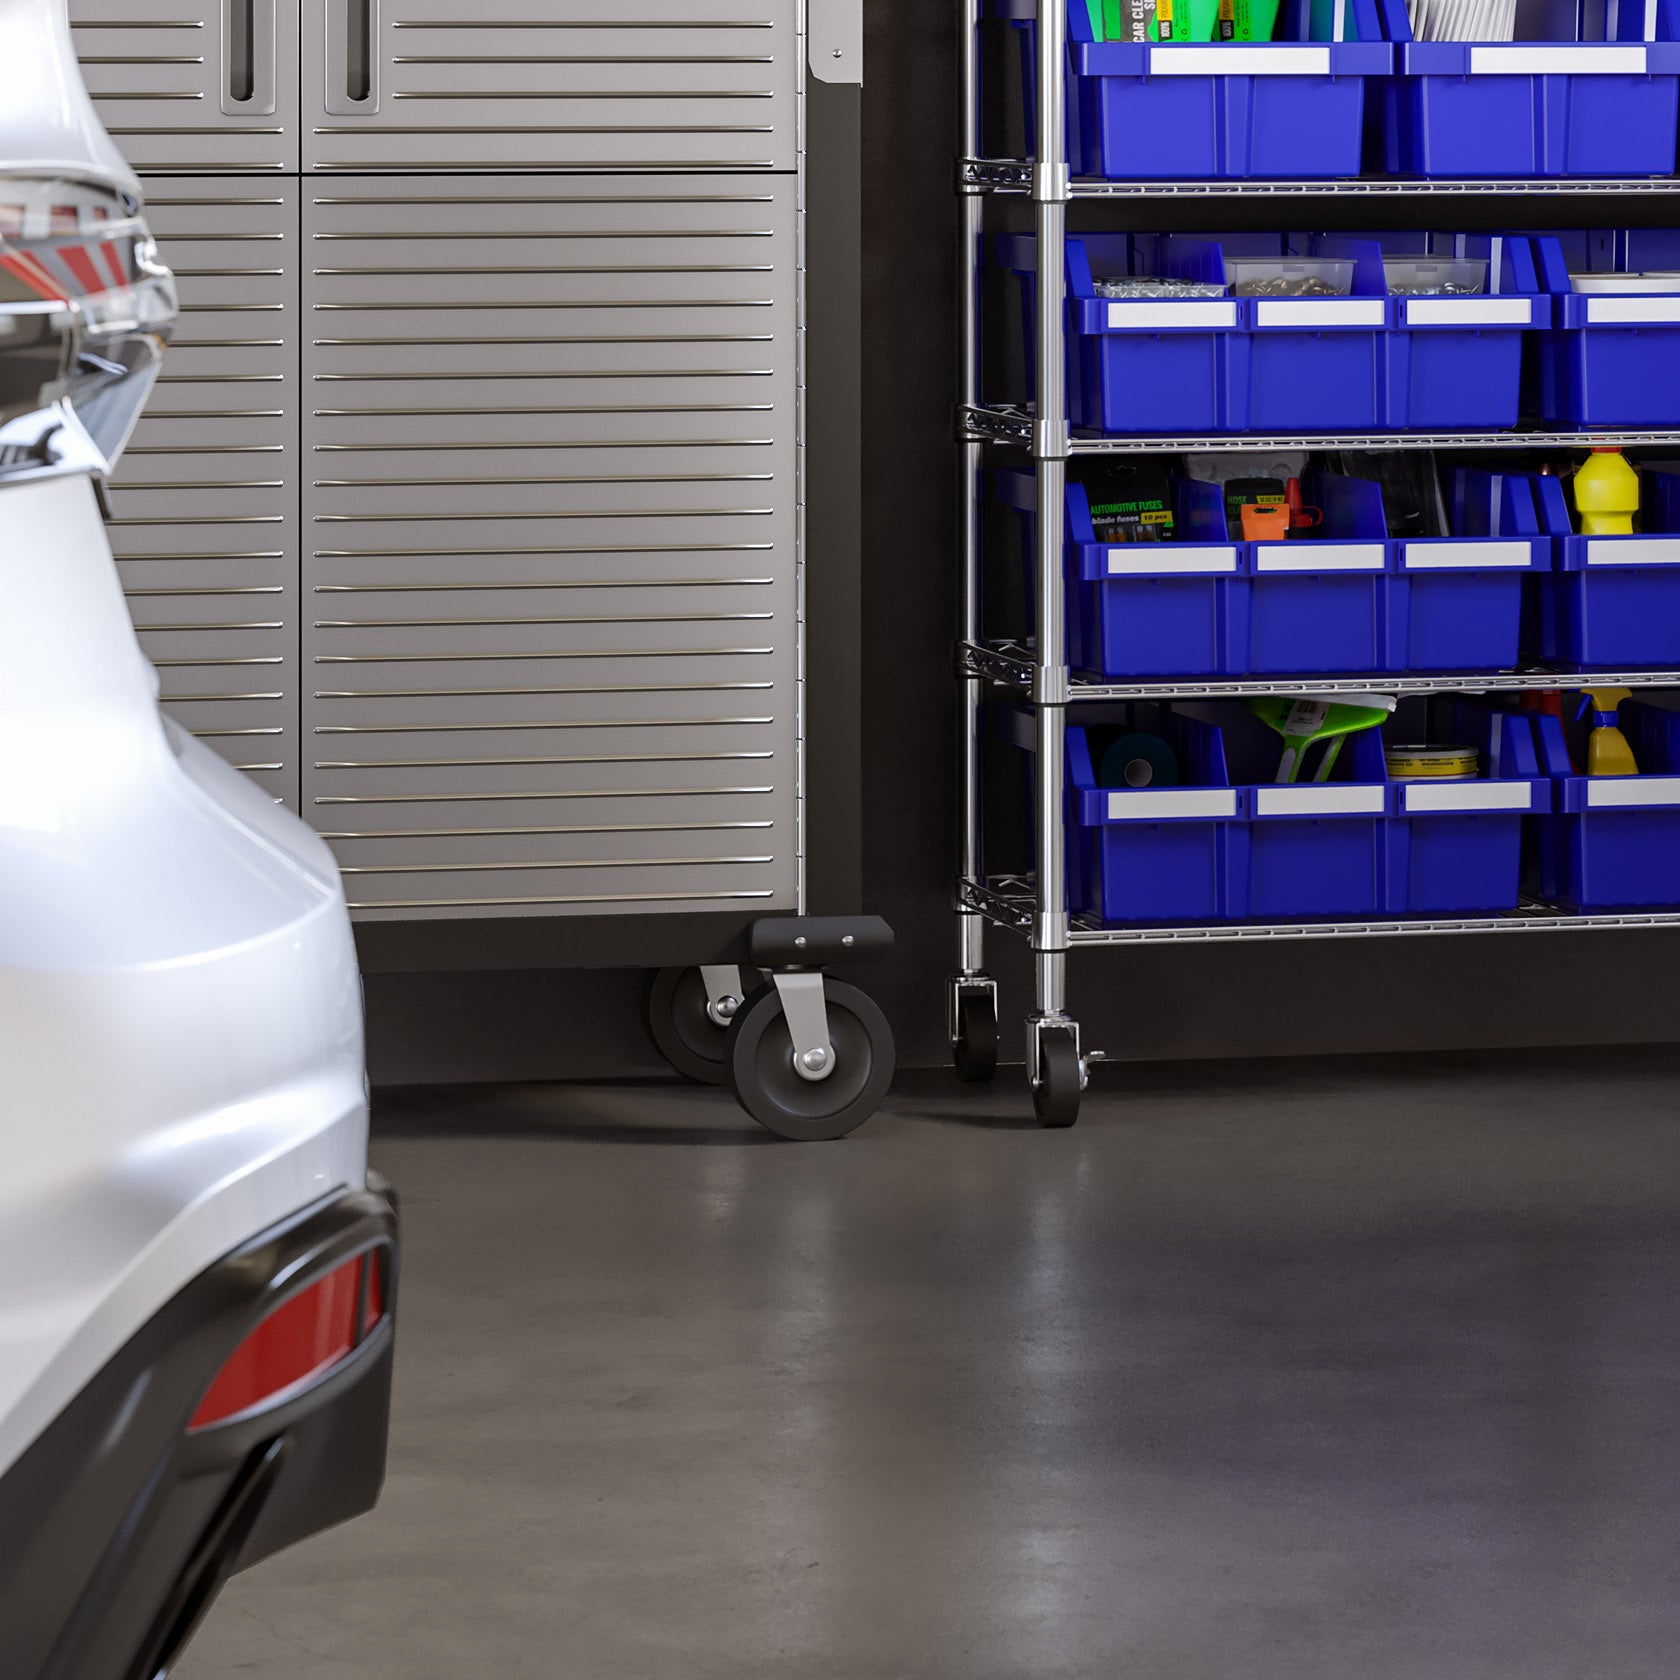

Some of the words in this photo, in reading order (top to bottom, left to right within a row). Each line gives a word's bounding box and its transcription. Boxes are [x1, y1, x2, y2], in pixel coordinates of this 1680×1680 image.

[1133, 22, 1145, 42] CAR
[1160, 21, 1171, 38] 100%
[1222, 21, 1232, 38] 100%
[1090, 502, 1137, 514] AUTOMOTIVE
[1139, 500, 1163, 510] FUSES
[1091, 516, 1115, 525] blade
[1116, 515, 1140, 523] fuses
